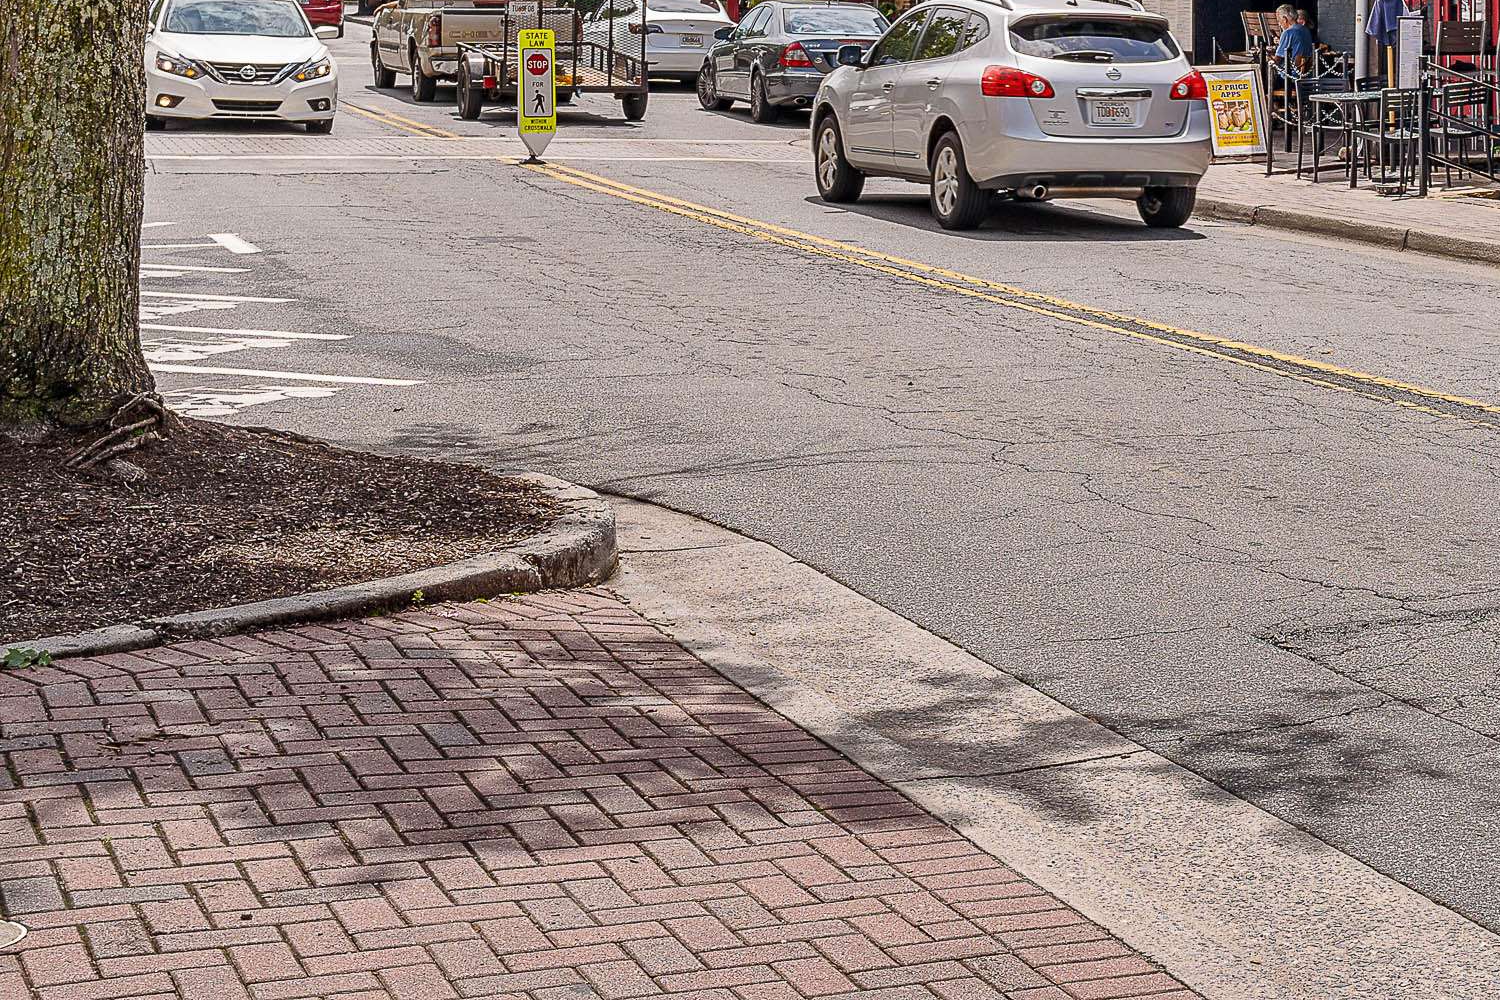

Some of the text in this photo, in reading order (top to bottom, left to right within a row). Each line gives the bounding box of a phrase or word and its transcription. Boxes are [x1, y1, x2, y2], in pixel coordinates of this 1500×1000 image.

[525, 32, 548, 40] STATE
[527, 60, 548, 69] STOP
[1224, 83, 1248, 91] PRICE
